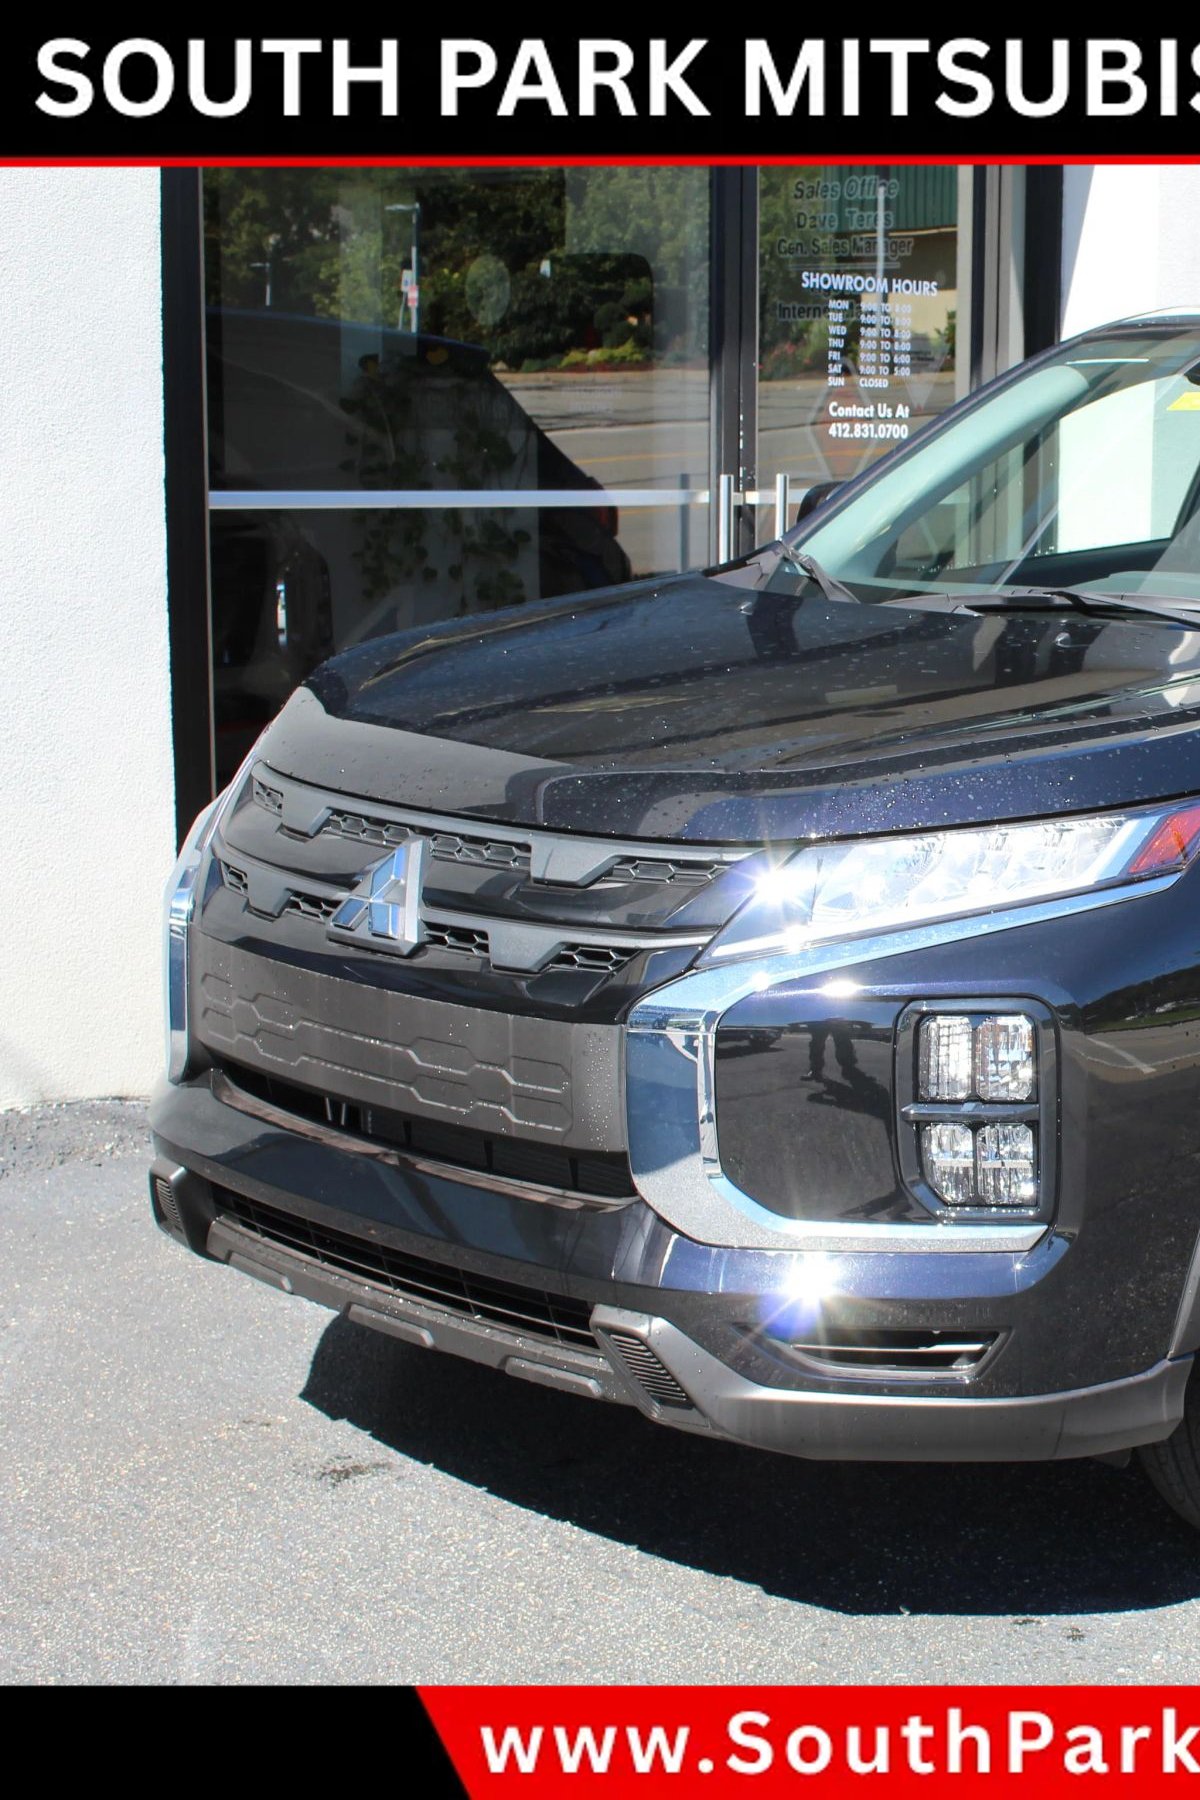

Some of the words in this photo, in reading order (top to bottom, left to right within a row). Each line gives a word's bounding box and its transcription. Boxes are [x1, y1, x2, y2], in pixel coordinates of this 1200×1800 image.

[793, 179, 841, 200] Sales
[844, 175, 900, 200] Office
[796, 211, 839, 230] Dave
[777, 237, 808, 257] Gen.
[811, 238, 850, 256] Sales
[801, 271, 888, 293] SHOWROOM
[892, 278, 938, 297] HOURS
[828, 299, 849, 310] MON
[881, 303, 891, 313] TO
[828, 312, 843, 323] TUE
[880, 315, 891, 326] TO
[828, 325, 847, 336] WED
[880, 328, 891, 339] TO
[828, 338, 844, 348] THU
[859, 340, 877, 350] 9:00
[880, 341, 891, 351] TO
[828, 350, 840, 361] FRI
[859, 352, 877, 363] 9:00
[880, 353, 891, 363] TO
[828, 363, 843, 374] SAT
[859, 365, 876, 375] 9:00
[879, 366, 890, 376] TO
[828, 376, 845, 387] SUN
[859, 378, 889, 388] CLOSED
[828, 401, 875, 418] Contact
[877, 403, 893, 419] Us
[895, 403, 910, 419] At
[828, 422, 909, 439] 412.831.0700
